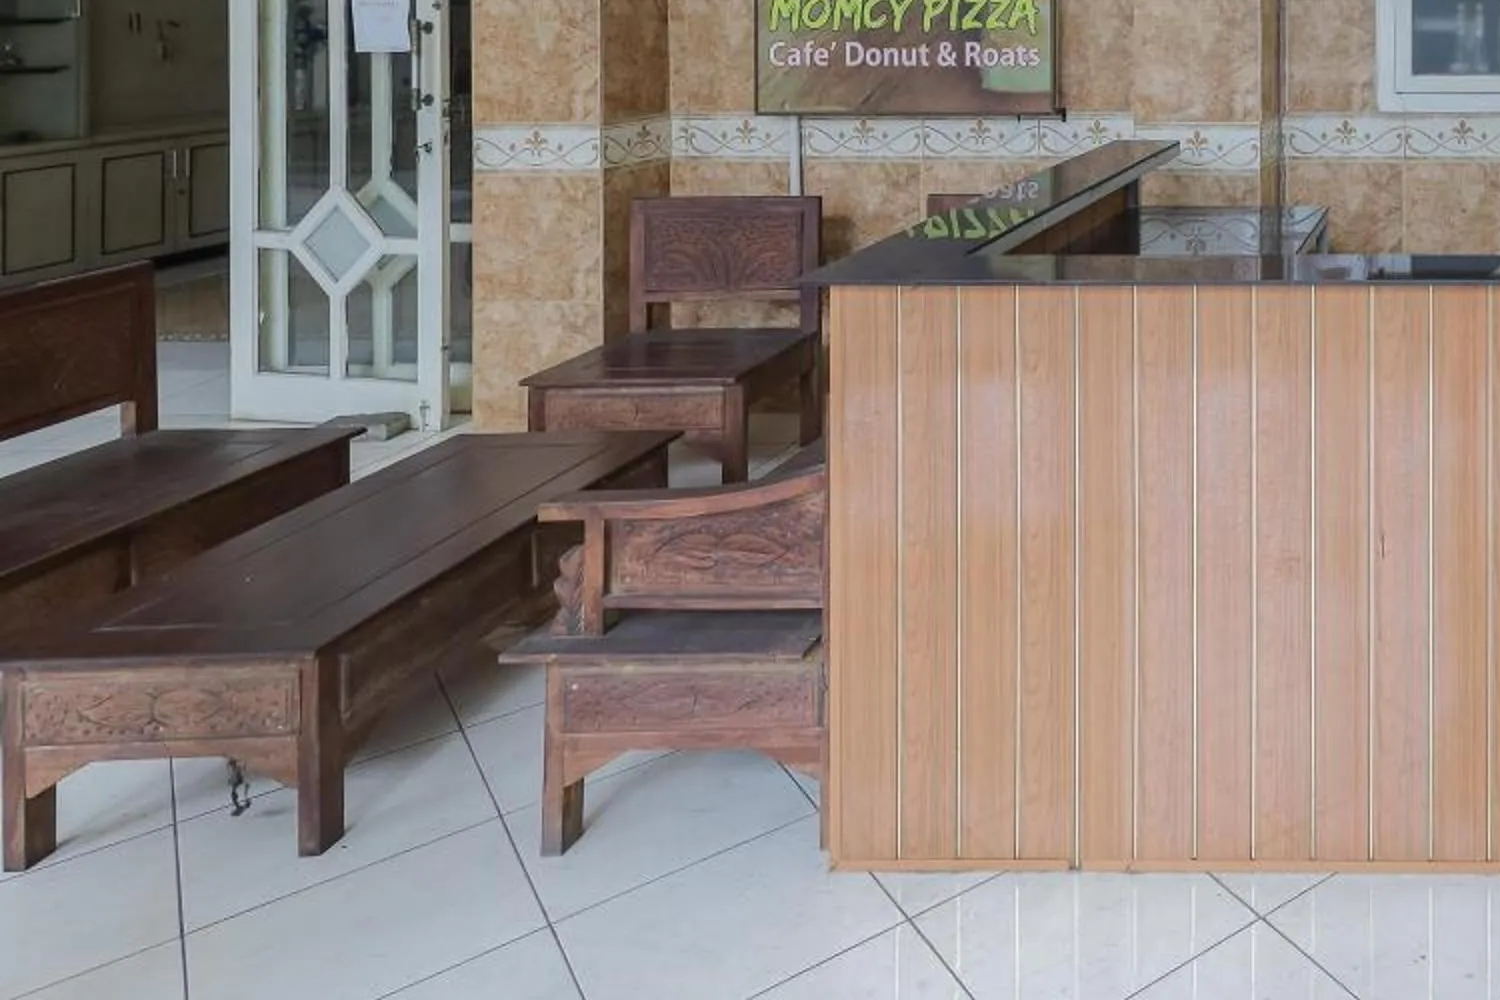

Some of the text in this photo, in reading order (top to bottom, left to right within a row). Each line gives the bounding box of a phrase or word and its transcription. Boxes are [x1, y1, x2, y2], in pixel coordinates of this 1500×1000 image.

[845, 42, 929, 67] Donut
[936, 42, 957, 67] &
[965, 42, 1041, 67] Roats
